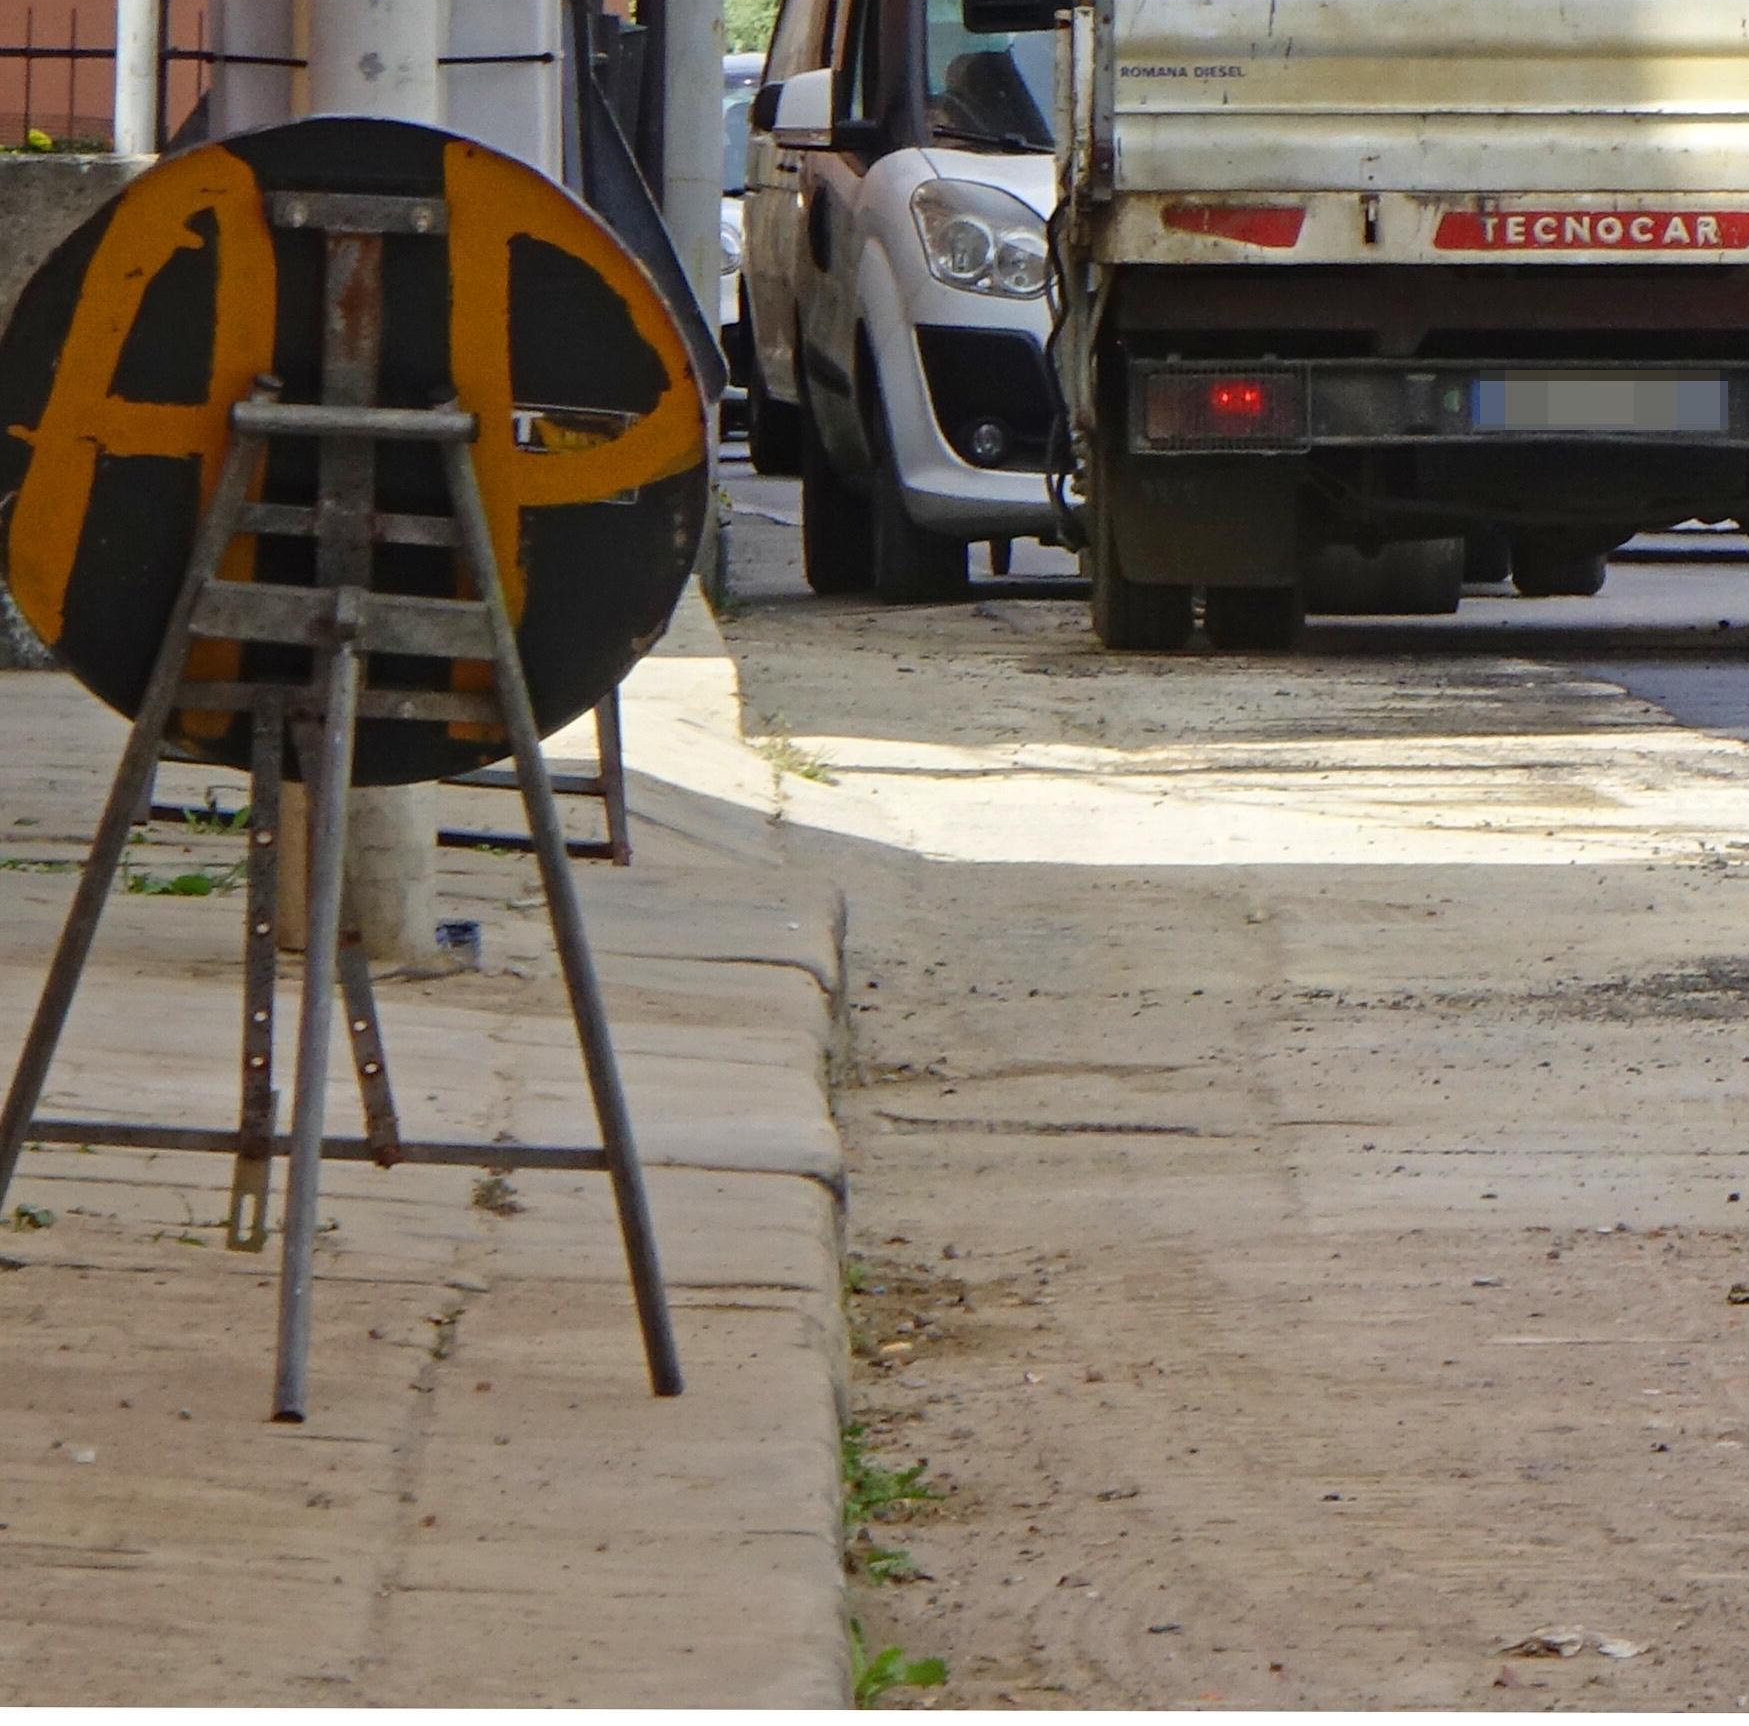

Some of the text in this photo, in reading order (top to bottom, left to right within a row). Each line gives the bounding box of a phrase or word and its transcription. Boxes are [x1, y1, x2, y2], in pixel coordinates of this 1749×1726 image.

[1120, 65, 1247, 78] ROMANA DIESEL
[1480, 215, 1720, 246] TECNOCAR
